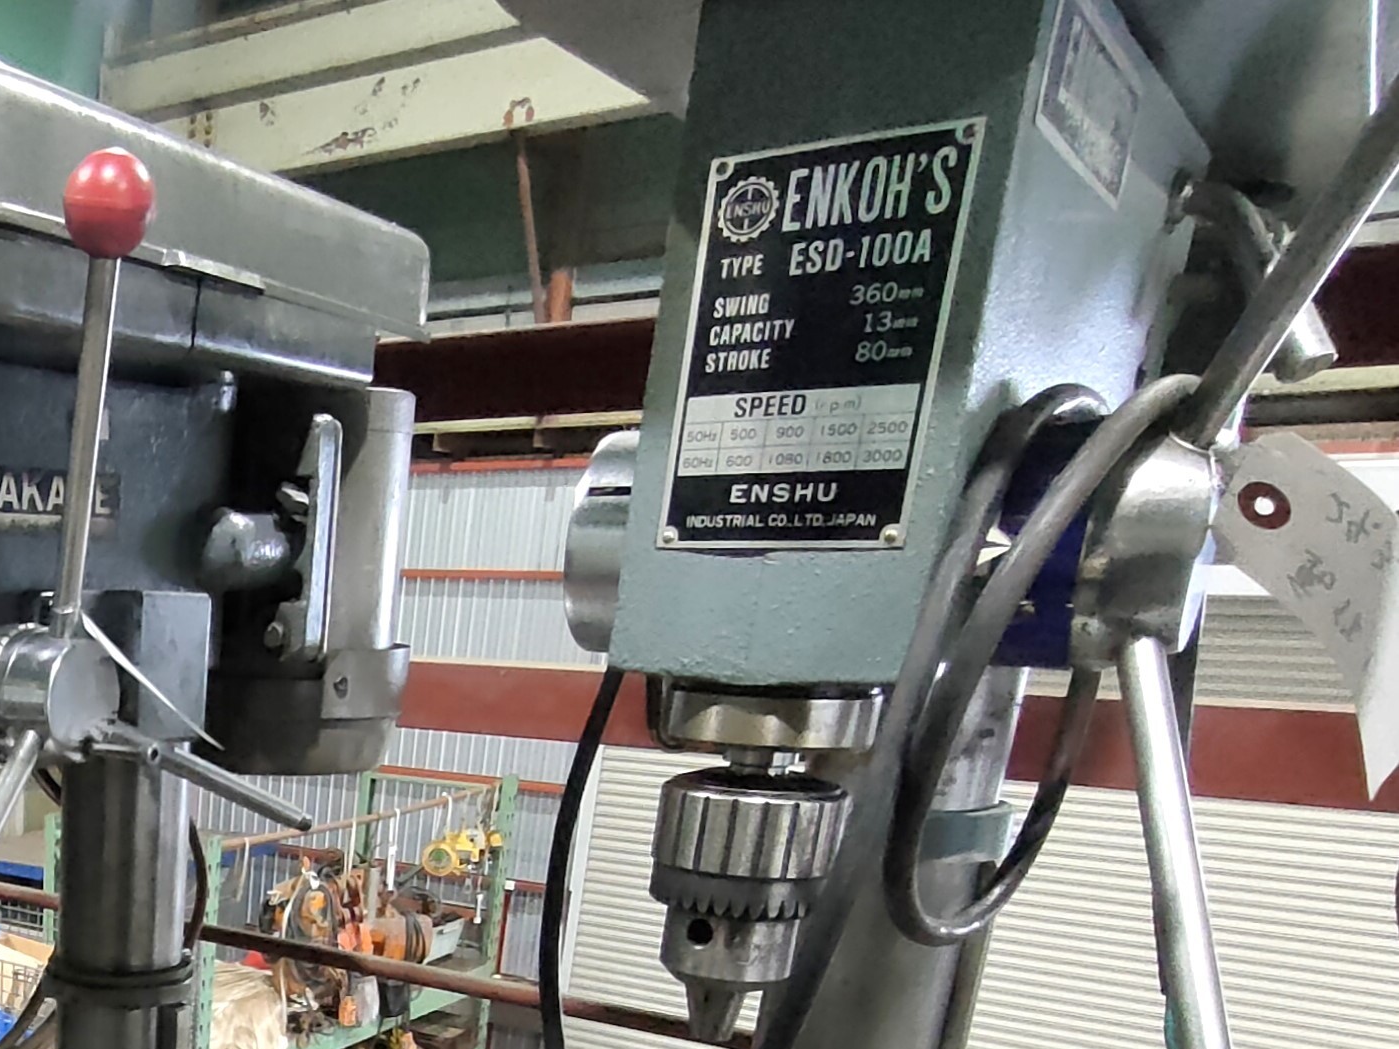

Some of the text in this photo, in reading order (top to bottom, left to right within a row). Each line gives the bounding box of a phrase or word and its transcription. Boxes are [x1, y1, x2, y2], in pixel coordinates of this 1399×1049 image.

[781, 146, 958, 232] ENKOH'S
[721, 228, 932, 279] TYPE ESD-100A
[713, 293, 770, 318] SWING
[709, 319, 795, 346] CAPACITY
[705, 348, 772, 373] STROKE
[734, 394, 807, 418] SPEED
[730, 428, 757, 441] 500
[776, 425, 805, 439] 900
[820, 423, 858, 436] 1500
[867, 420, 909, 435] 2500
[726, 455, 752, 467] 600
[863, 449, 903, 463] 3000
[729, 482, 838, 503] ENSHU
[686, 514, 765, 528] INDUSTRIAL
